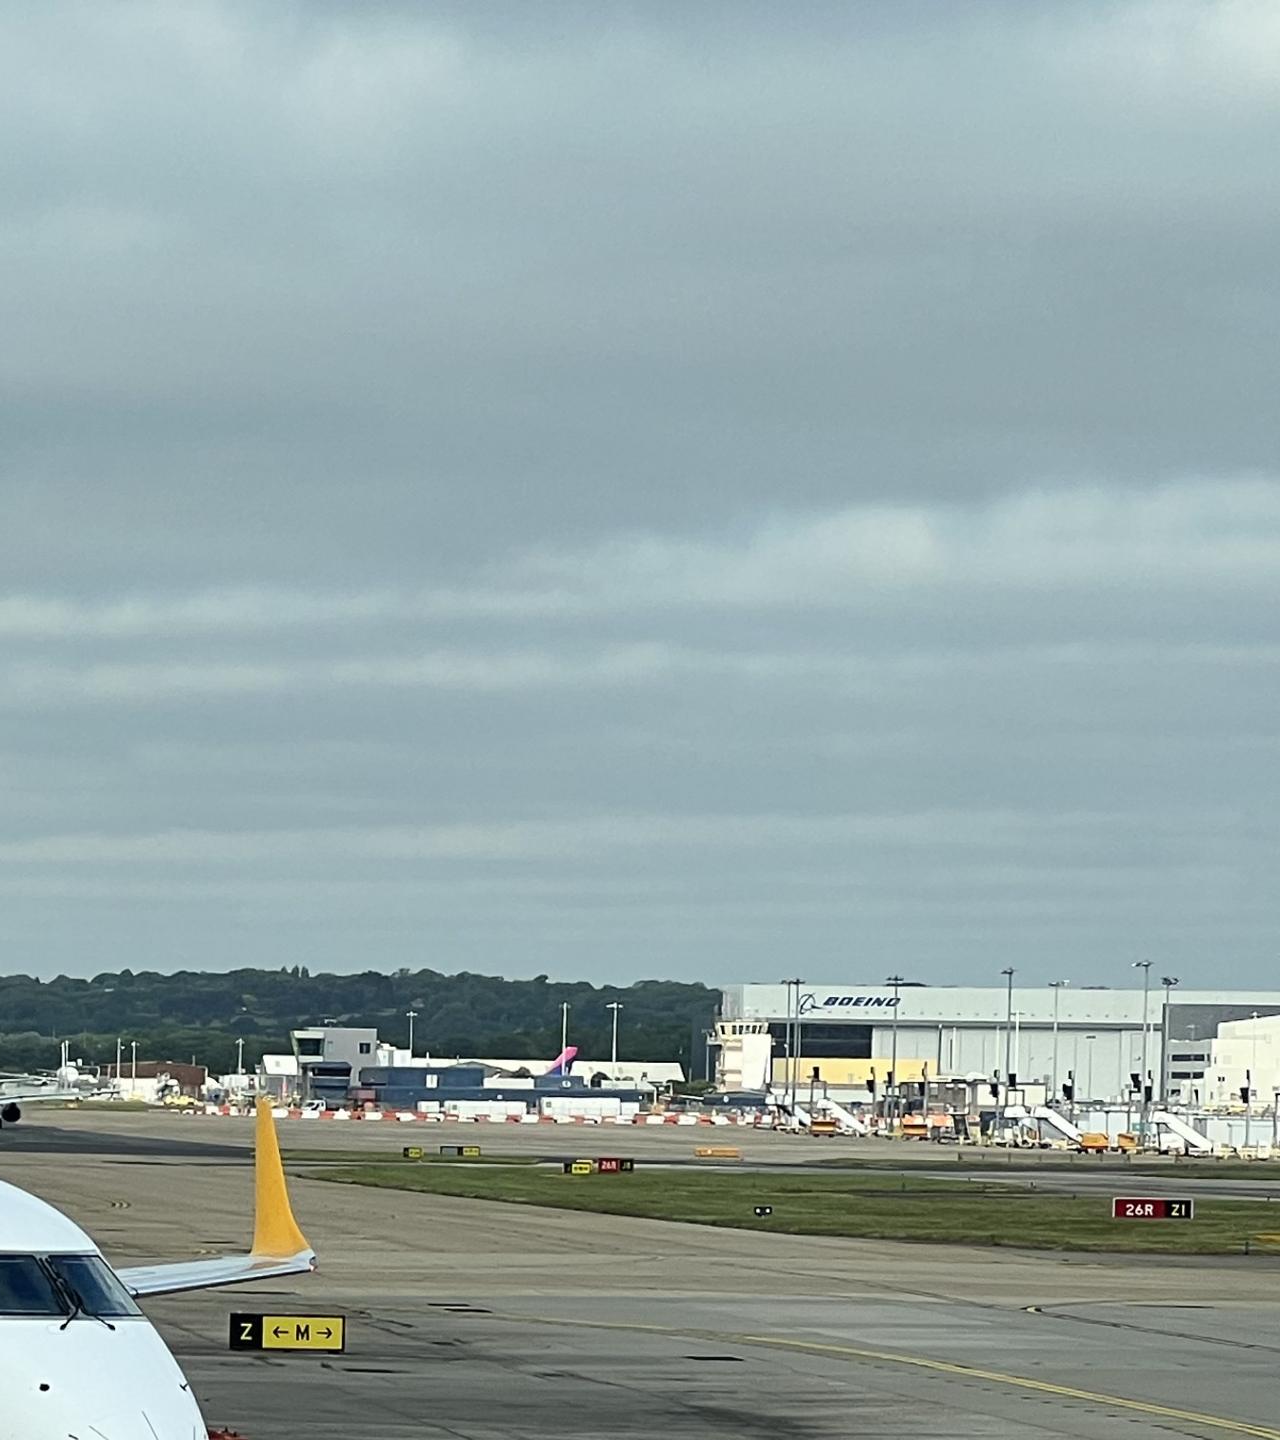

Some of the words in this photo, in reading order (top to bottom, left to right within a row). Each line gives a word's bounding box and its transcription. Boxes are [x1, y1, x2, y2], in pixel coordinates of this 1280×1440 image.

[823, 996, 901, 1007] BOEING
[1125, 1203, 1154, 1216] 26R
[239, 1323, 253, 1341] Z
[295, 1323, 311, 1341] M
